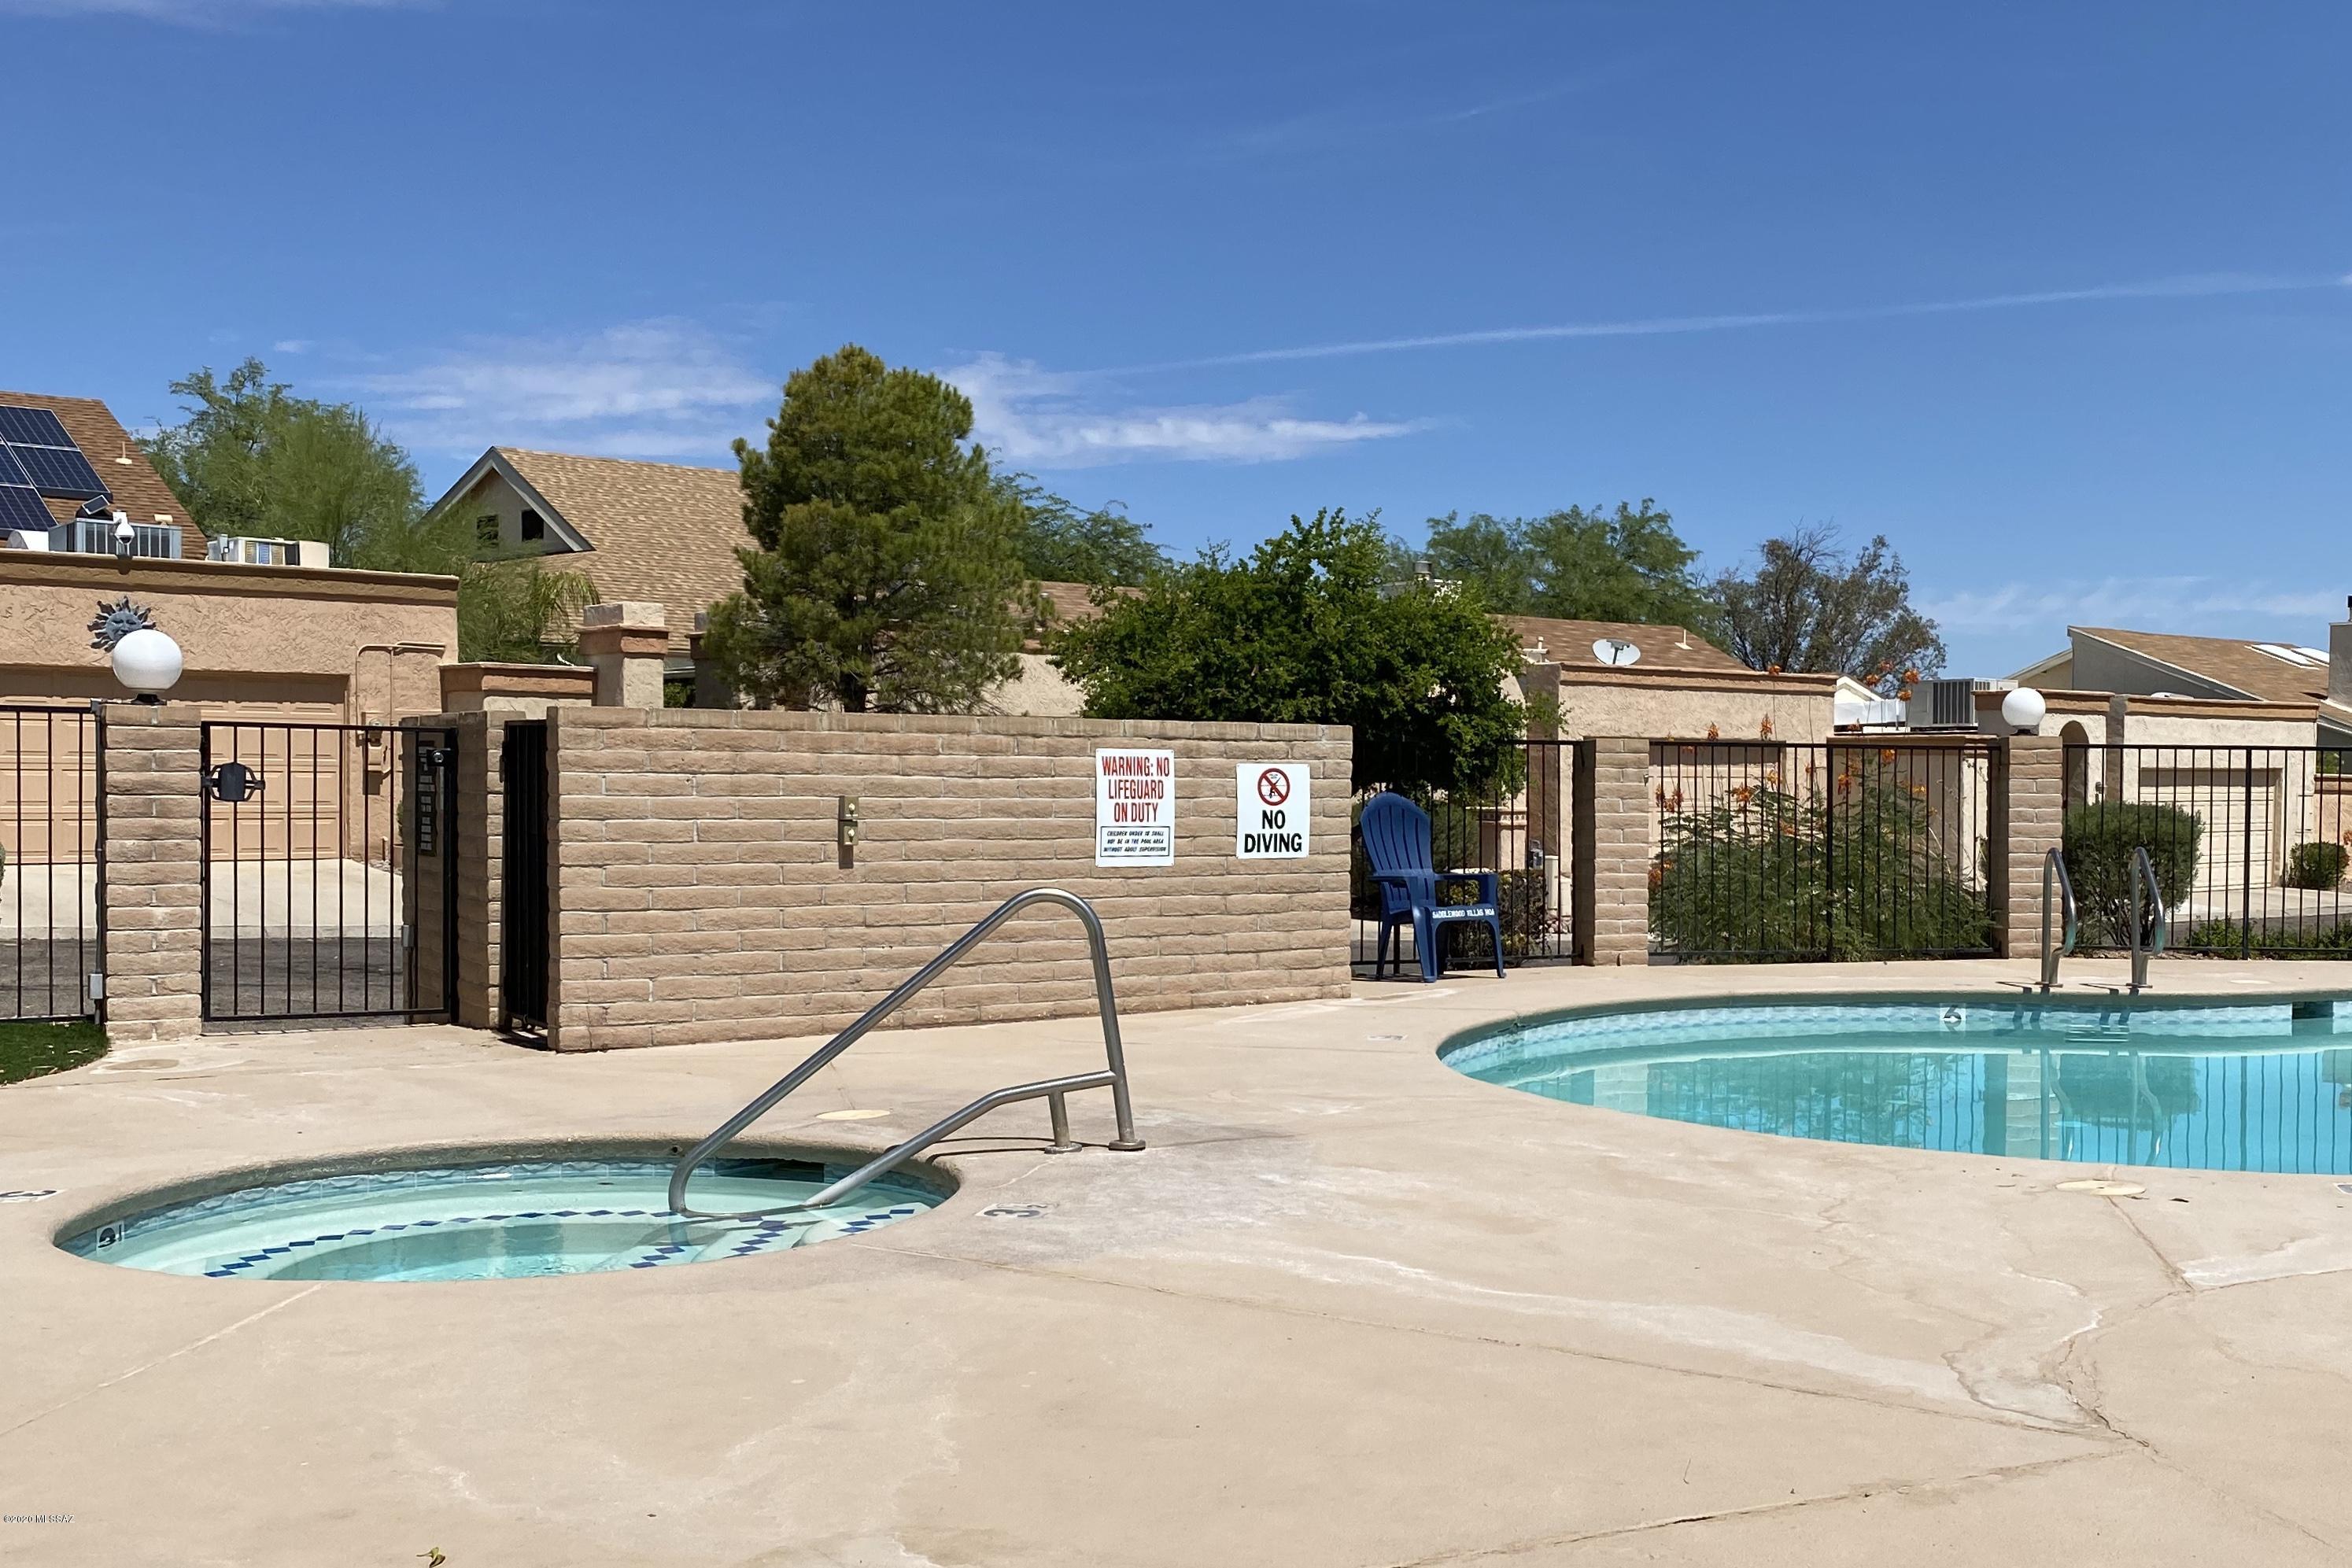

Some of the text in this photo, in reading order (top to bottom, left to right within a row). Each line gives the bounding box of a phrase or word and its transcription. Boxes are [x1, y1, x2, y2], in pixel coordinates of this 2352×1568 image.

[1102, 756, 1169, 777] WARNING: NO
[1108, 780, 1164, 799] LIFEGUARD
[1114, 802, 1158, 822] ON DUTY
[1261, 810, 1286, 829] NO
[1244, 832, 1302, 853] DIVING
